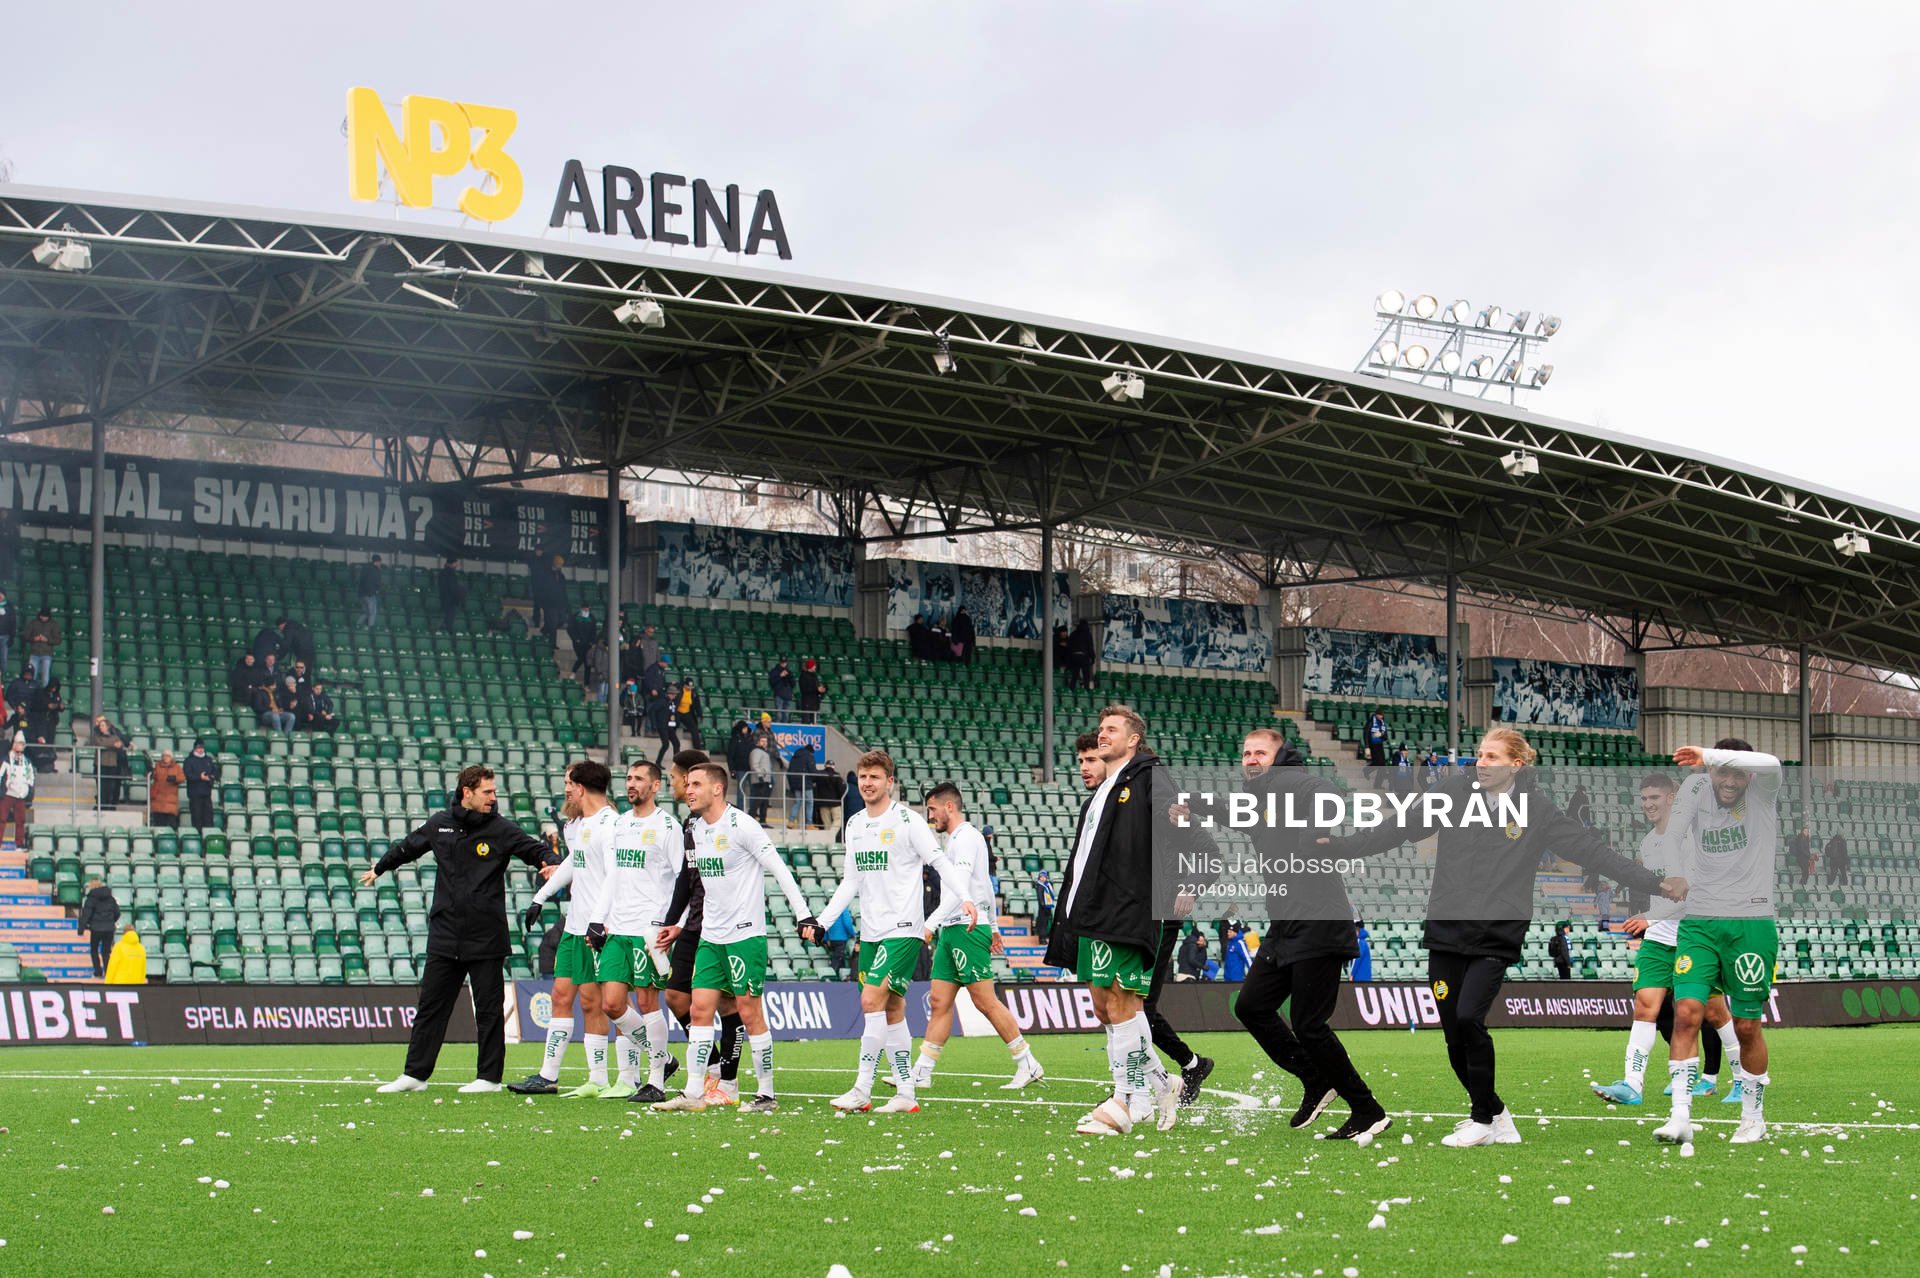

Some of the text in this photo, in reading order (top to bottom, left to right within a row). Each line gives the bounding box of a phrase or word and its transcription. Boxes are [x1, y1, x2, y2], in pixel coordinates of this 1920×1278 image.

[347, 86, 792, 260] NP3 ARENA
[193, 477, 336, 534] SKARU
[1701, 825, 1747, 846] HUSKI
[616, 848, 646, 862] HUSKI
[1702, 840, 1748, 854] CHOCOLATE
[697, 857, 725, 871] HUSKI
[855, 850, 888, 865] HUSKI
[857, 864, 888, 872] CHOCOLATE
[1005, 988, 1101, 1030] UNIB
[1355, 987, 1441, 1025] UNIB
[1505, 998, 1544, 1015] SPELA
[1546, 998, 1629, 1015] ANSVARSFULLT
[184, 1006, 248, 1029] SPELA
[253, 1006, 393, 1029] ANSVARSFULLT
